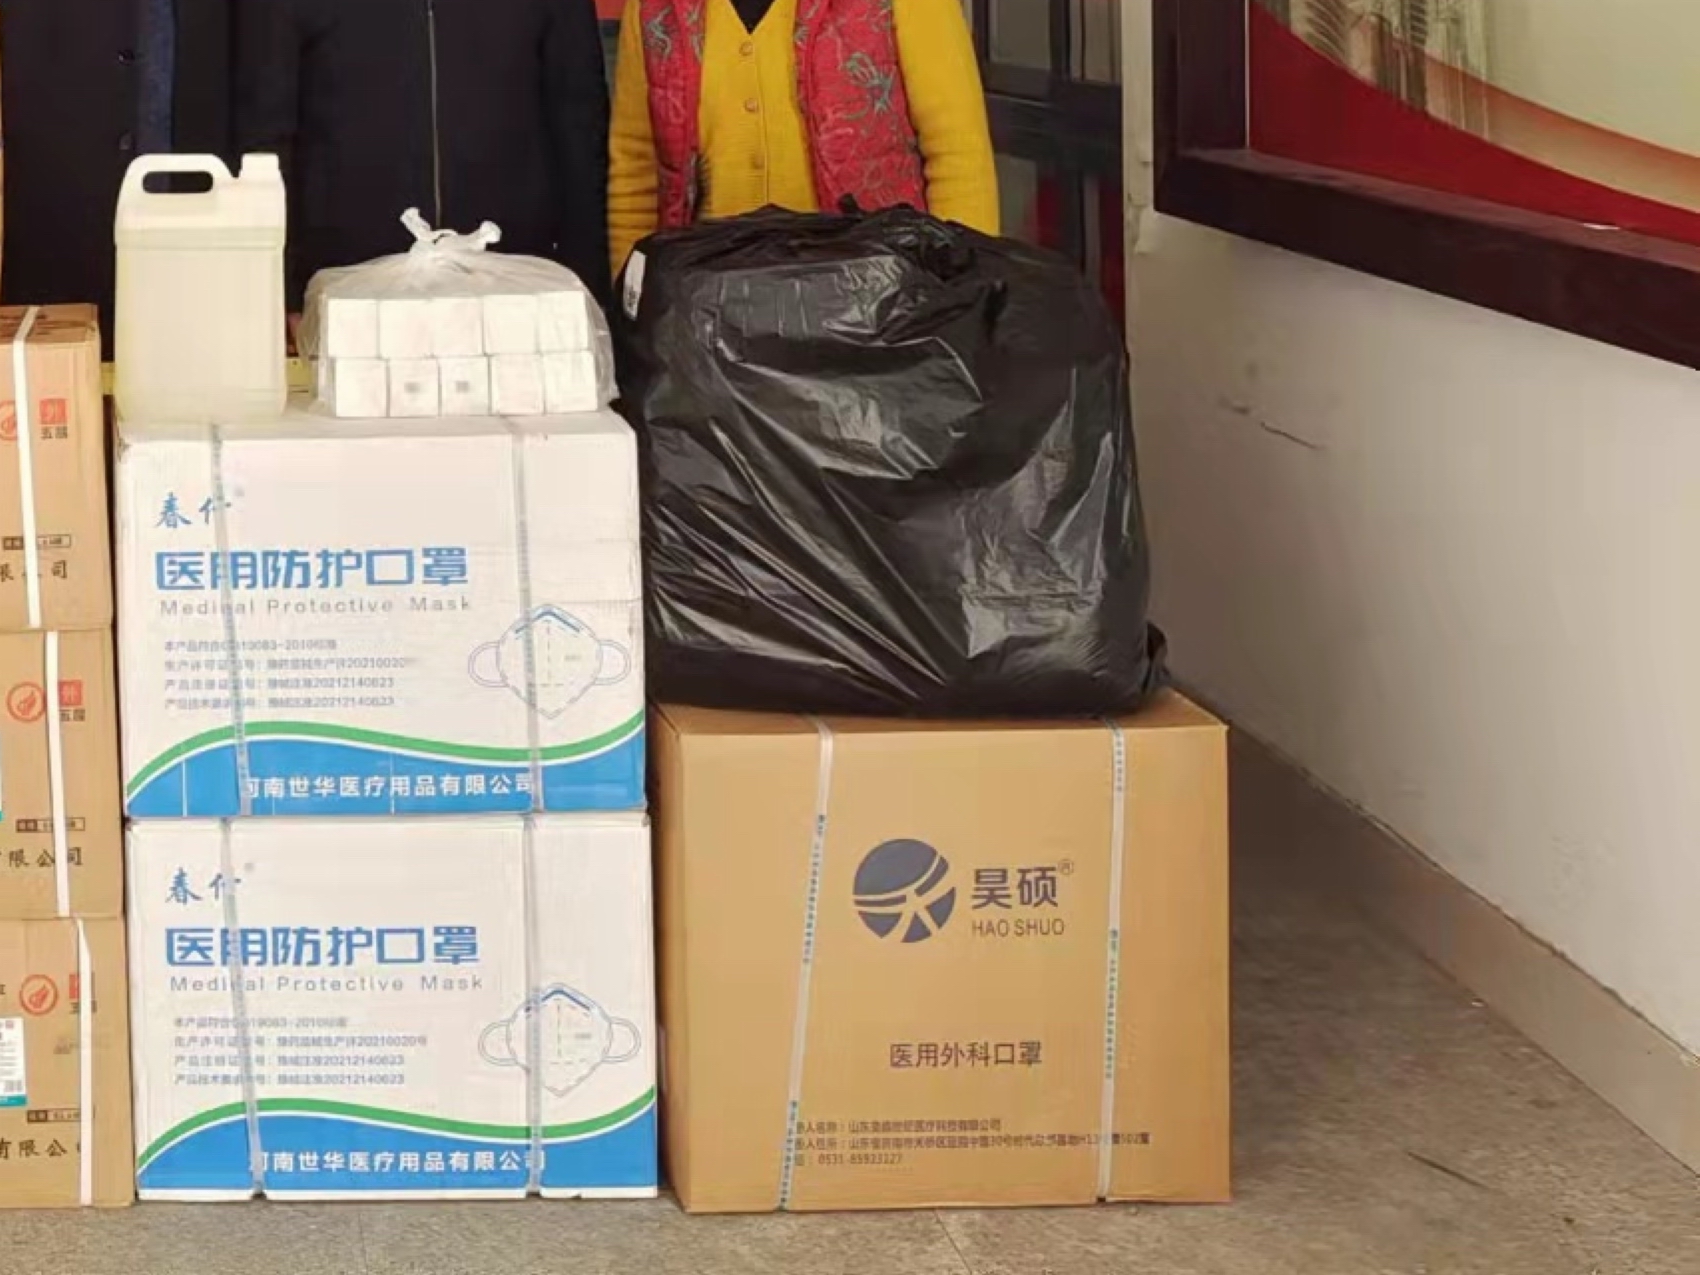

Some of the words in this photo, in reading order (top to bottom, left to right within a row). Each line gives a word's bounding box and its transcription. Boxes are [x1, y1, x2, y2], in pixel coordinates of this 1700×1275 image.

[155, 546, 469, 591] 医用防护口罩
[267, 596, 393, 614] Protective
[410, 595, 472, 612] Mask
[971, 865, 1059, 910] 昊硕
[971, 919, 1010, 937] HAO
[1013, 918, 1065, 936] SHUO
[165, 925, 480, 966] 医用防护口罩
[277, 975, 403, 992] Protective
[420, 974, 484, 991] Mask
[889, 1040, 1043, 1069] 医用外科口罩
